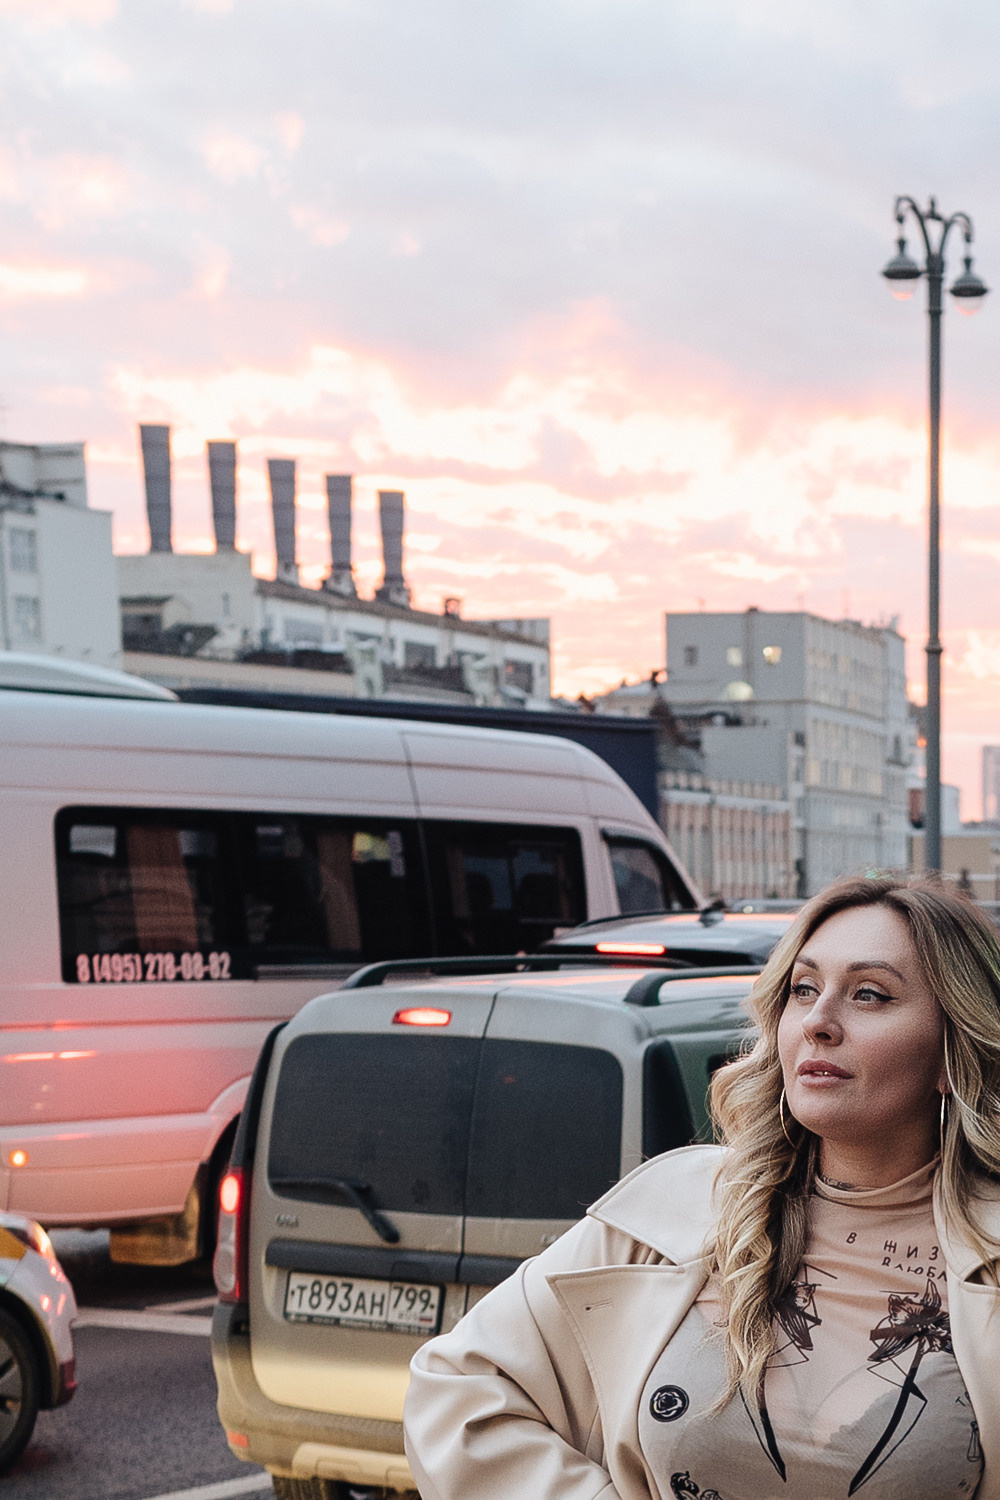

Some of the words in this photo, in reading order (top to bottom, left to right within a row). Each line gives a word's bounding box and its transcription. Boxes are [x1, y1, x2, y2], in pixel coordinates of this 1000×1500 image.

[76, 953, 90, 982] 8
[92, 953, 142, 981] (495)
[846, 1232, 857, 1244] В
[297, 1280, 385, 1316] Т893АН
[392, 1286, 431, 1313] 799
